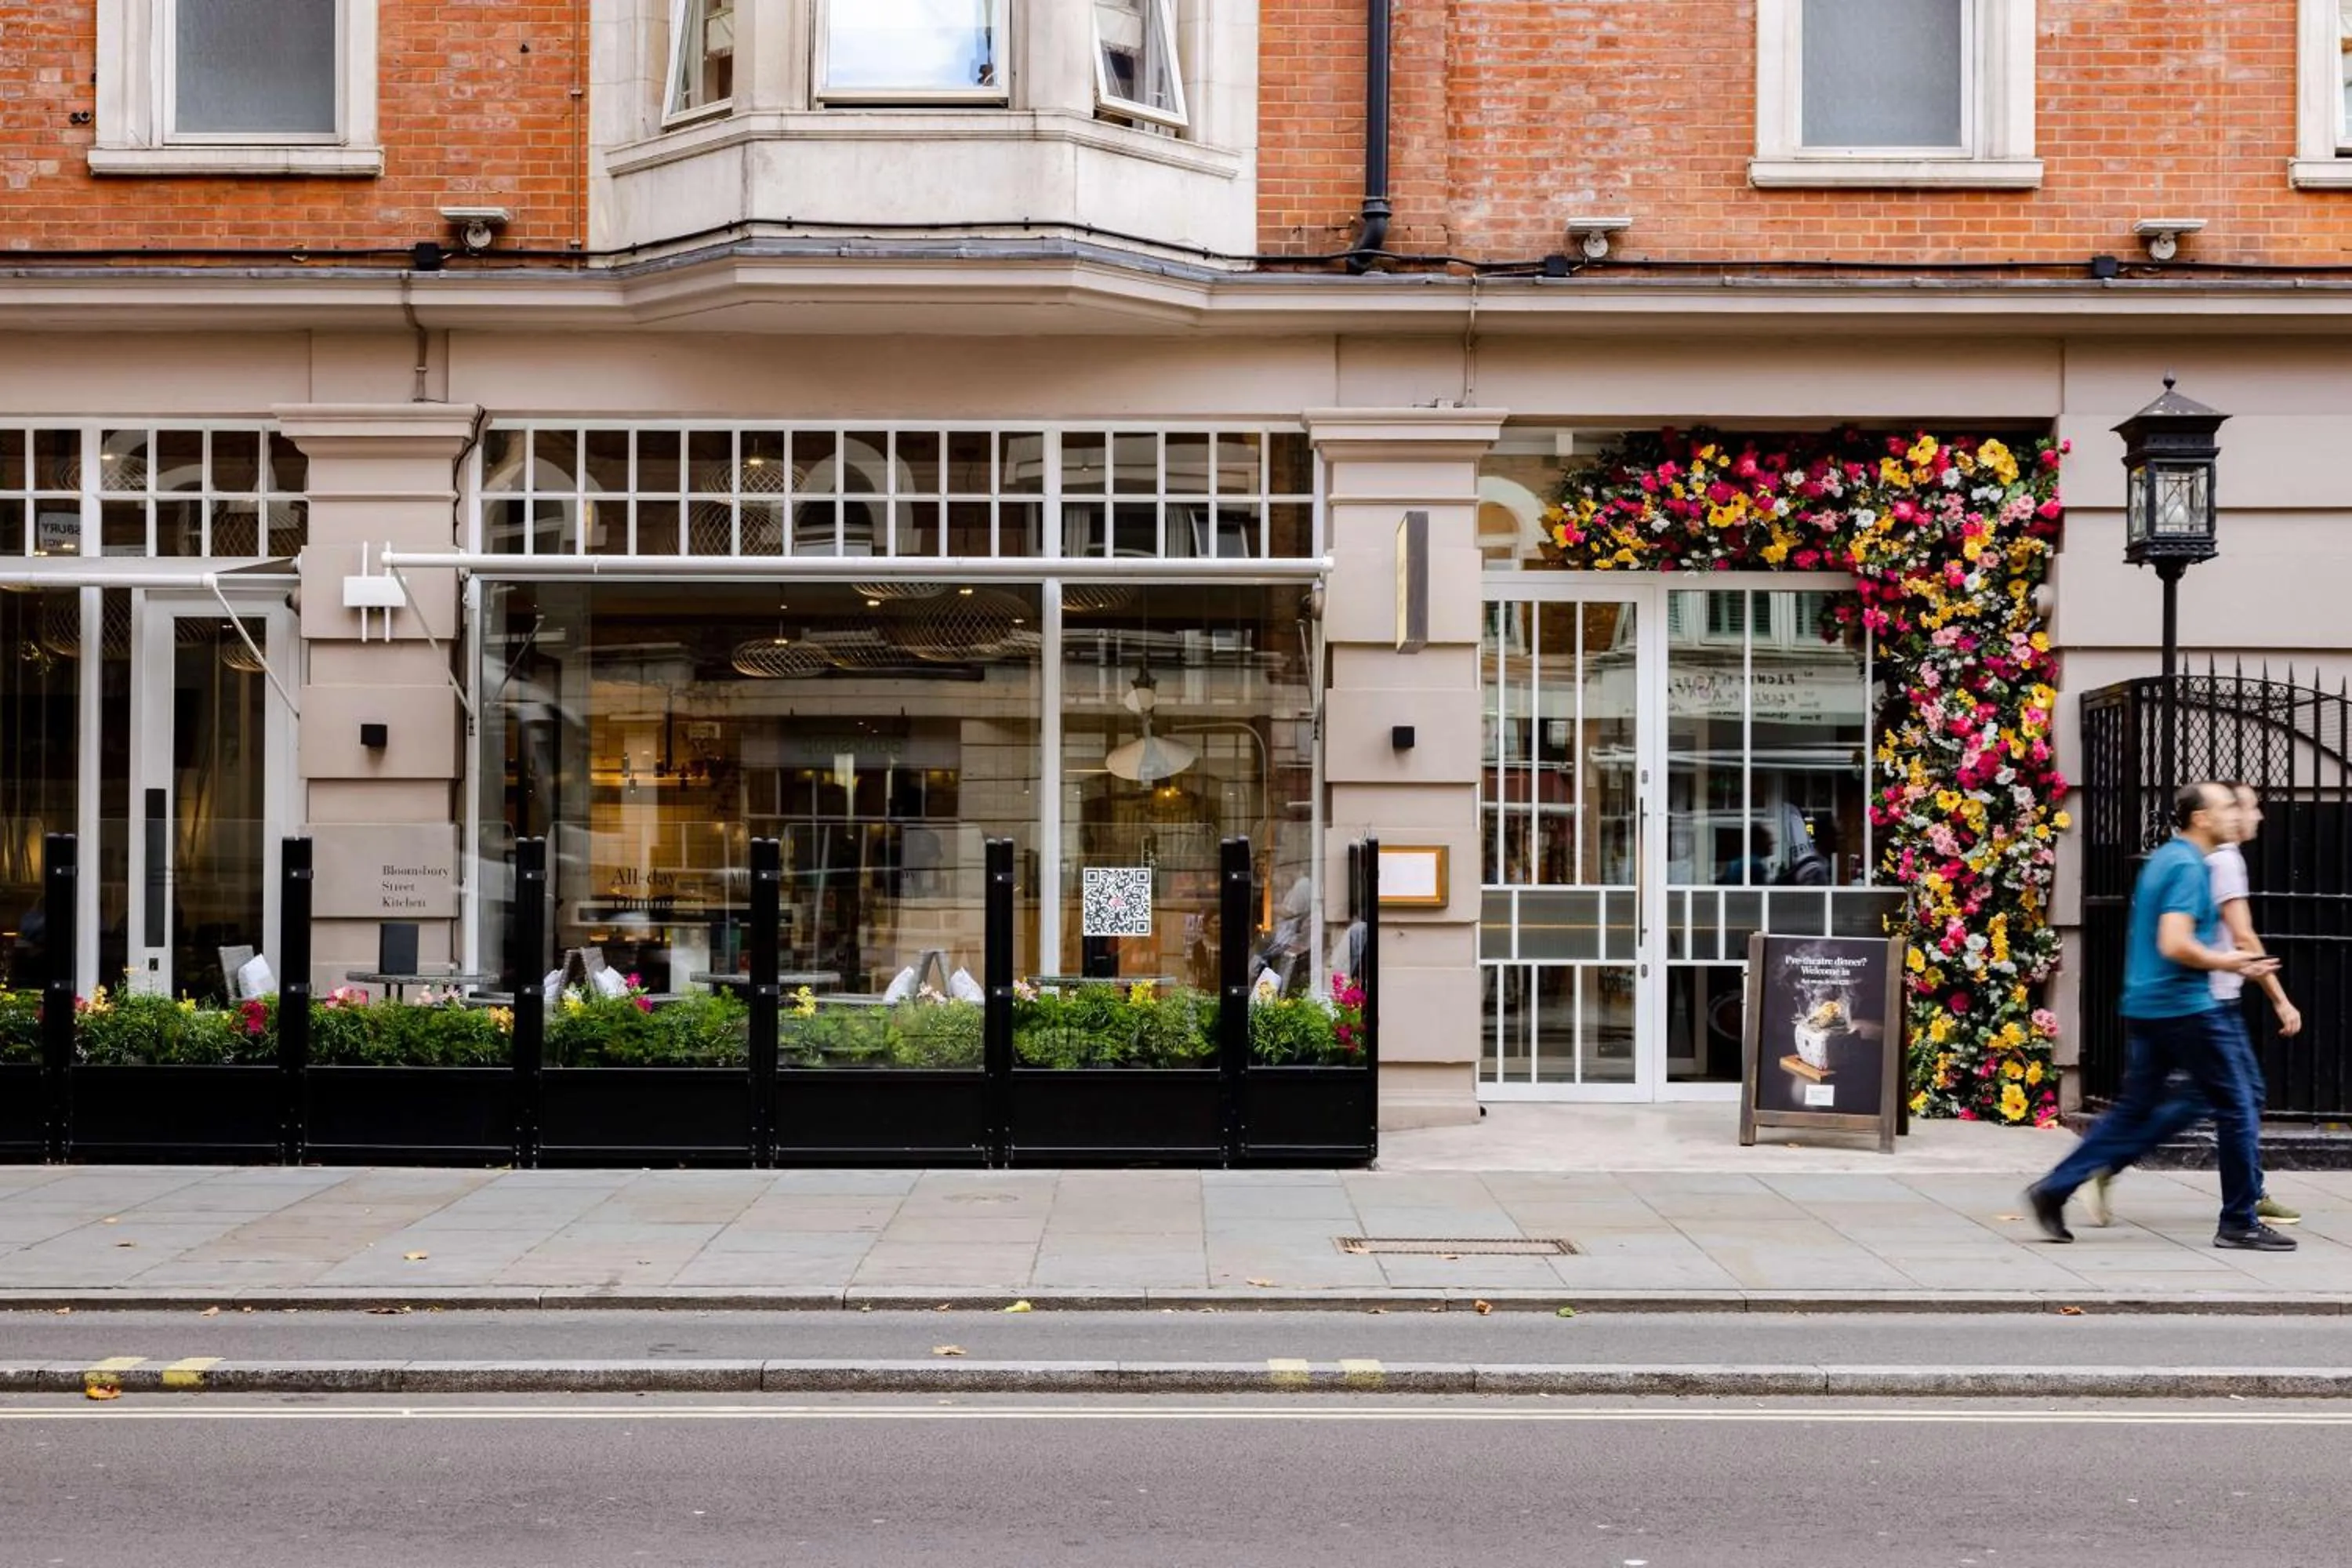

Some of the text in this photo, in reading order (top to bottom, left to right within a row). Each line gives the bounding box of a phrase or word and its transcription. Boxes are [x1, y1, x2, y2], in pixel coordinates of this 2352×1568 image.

[382, 865, 448, 878] Bloomsbury
[610, 867, 677, 889] All-day
[382, 880, 415, 891] Street
[382, 896, 426, 907] Kitchen
[1801, 965, 1839, 976] Welcome
